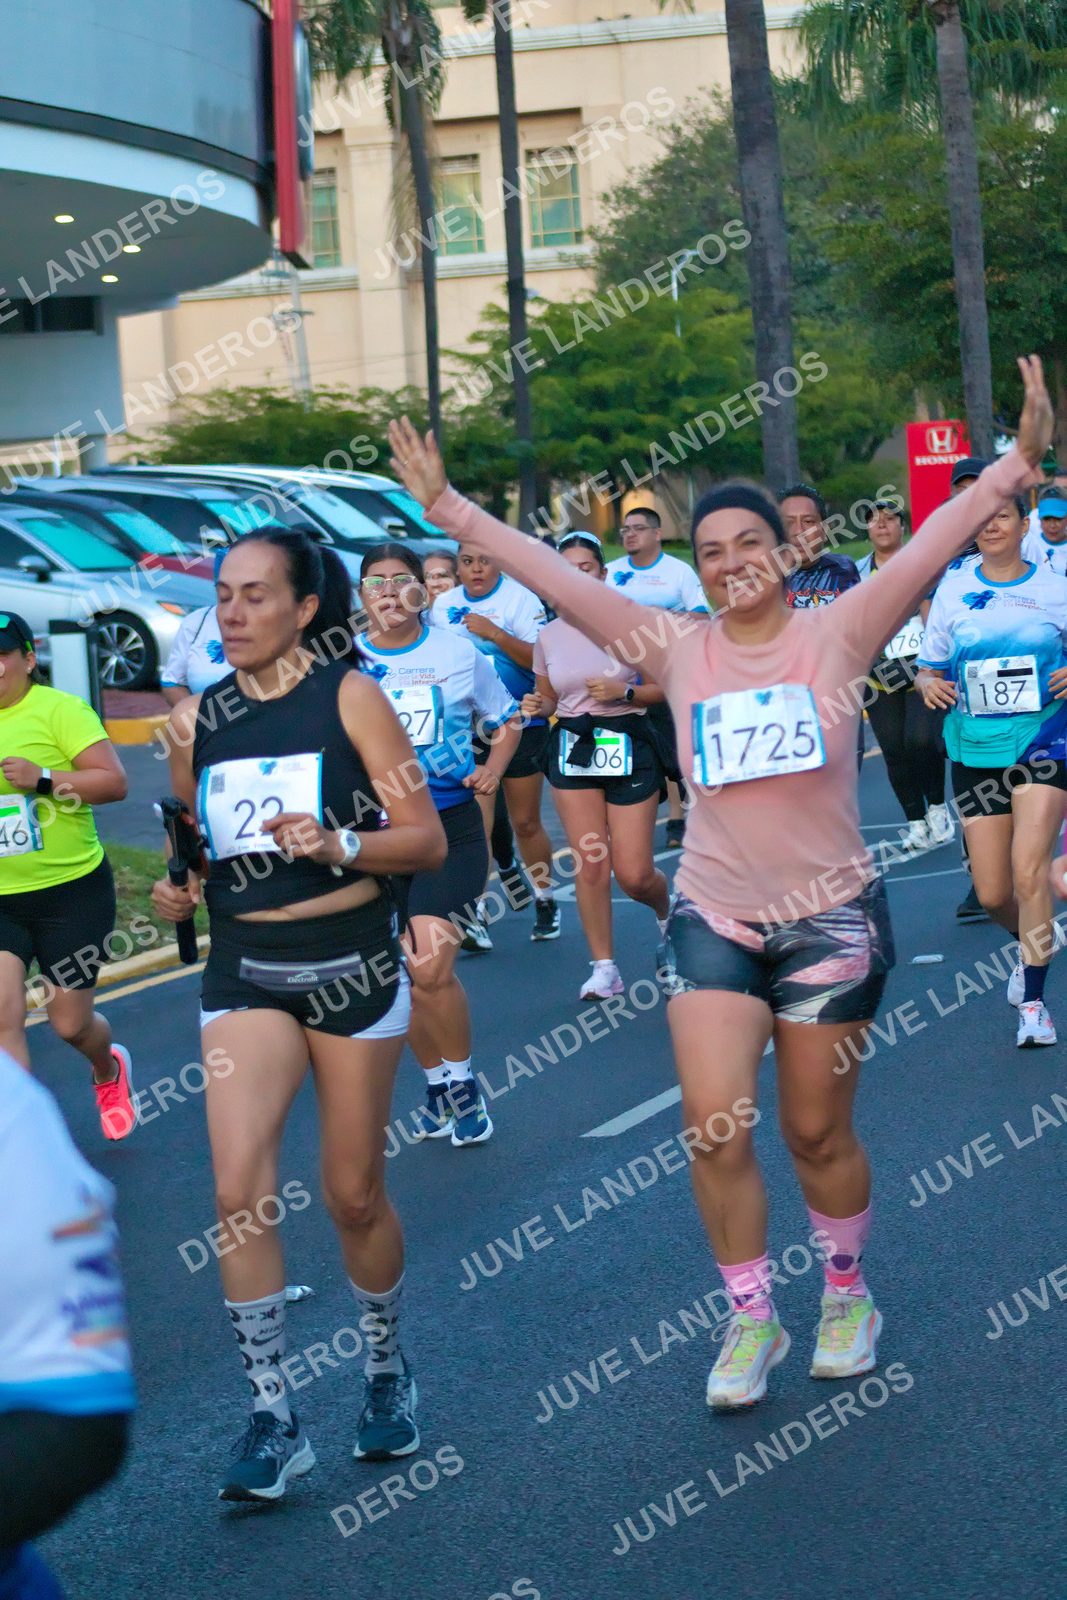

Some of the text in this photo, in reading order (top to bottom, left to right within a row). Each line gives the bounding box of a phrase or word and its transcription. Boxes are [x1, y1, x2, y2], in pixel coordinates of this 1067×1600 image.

[399, 667, 434, 675] Carrera
[979, 680, 1027, 706] 187
[711, 720, 815, 771] 1725
[234, 796, 284, 841] 22
